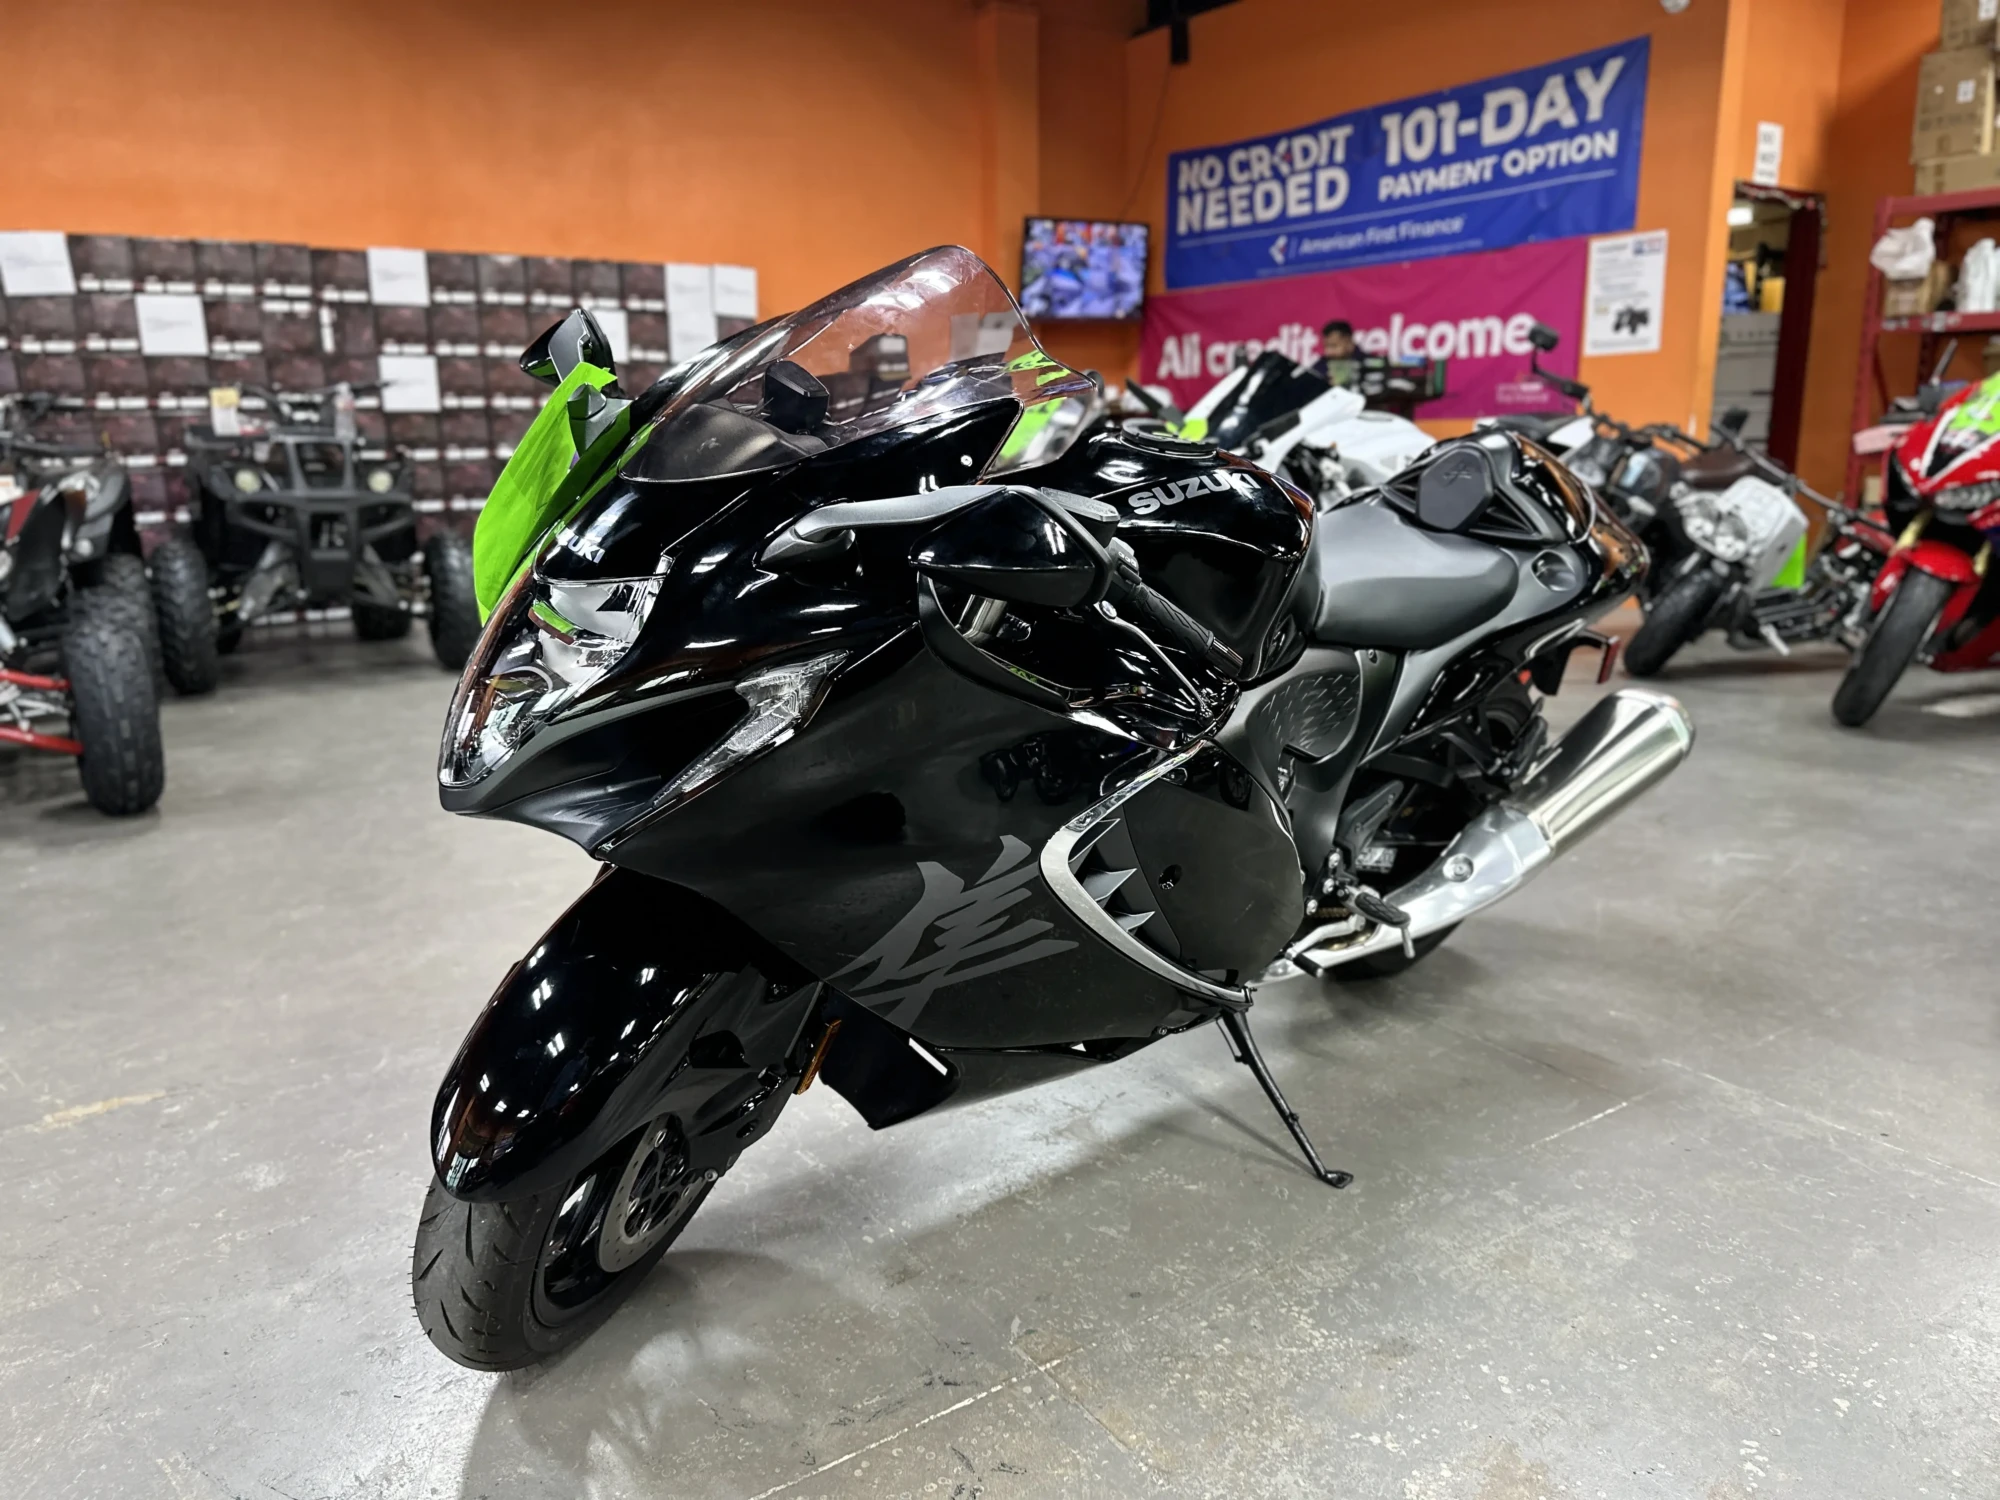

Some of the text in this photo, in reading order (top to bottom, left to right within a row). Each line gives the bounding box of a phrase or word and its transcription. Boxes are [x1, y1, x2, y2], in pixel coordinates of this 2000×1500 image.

[1381, 56, 1626, 167] 101-DAY
[1178, 155, 1224, 193] NO
[1378, 128, 1619, 203] PAYMENT OPTION
[1176, 166, 1349, 236] NEEDED
[1128, 472, 1262, 515] SUZUKI
